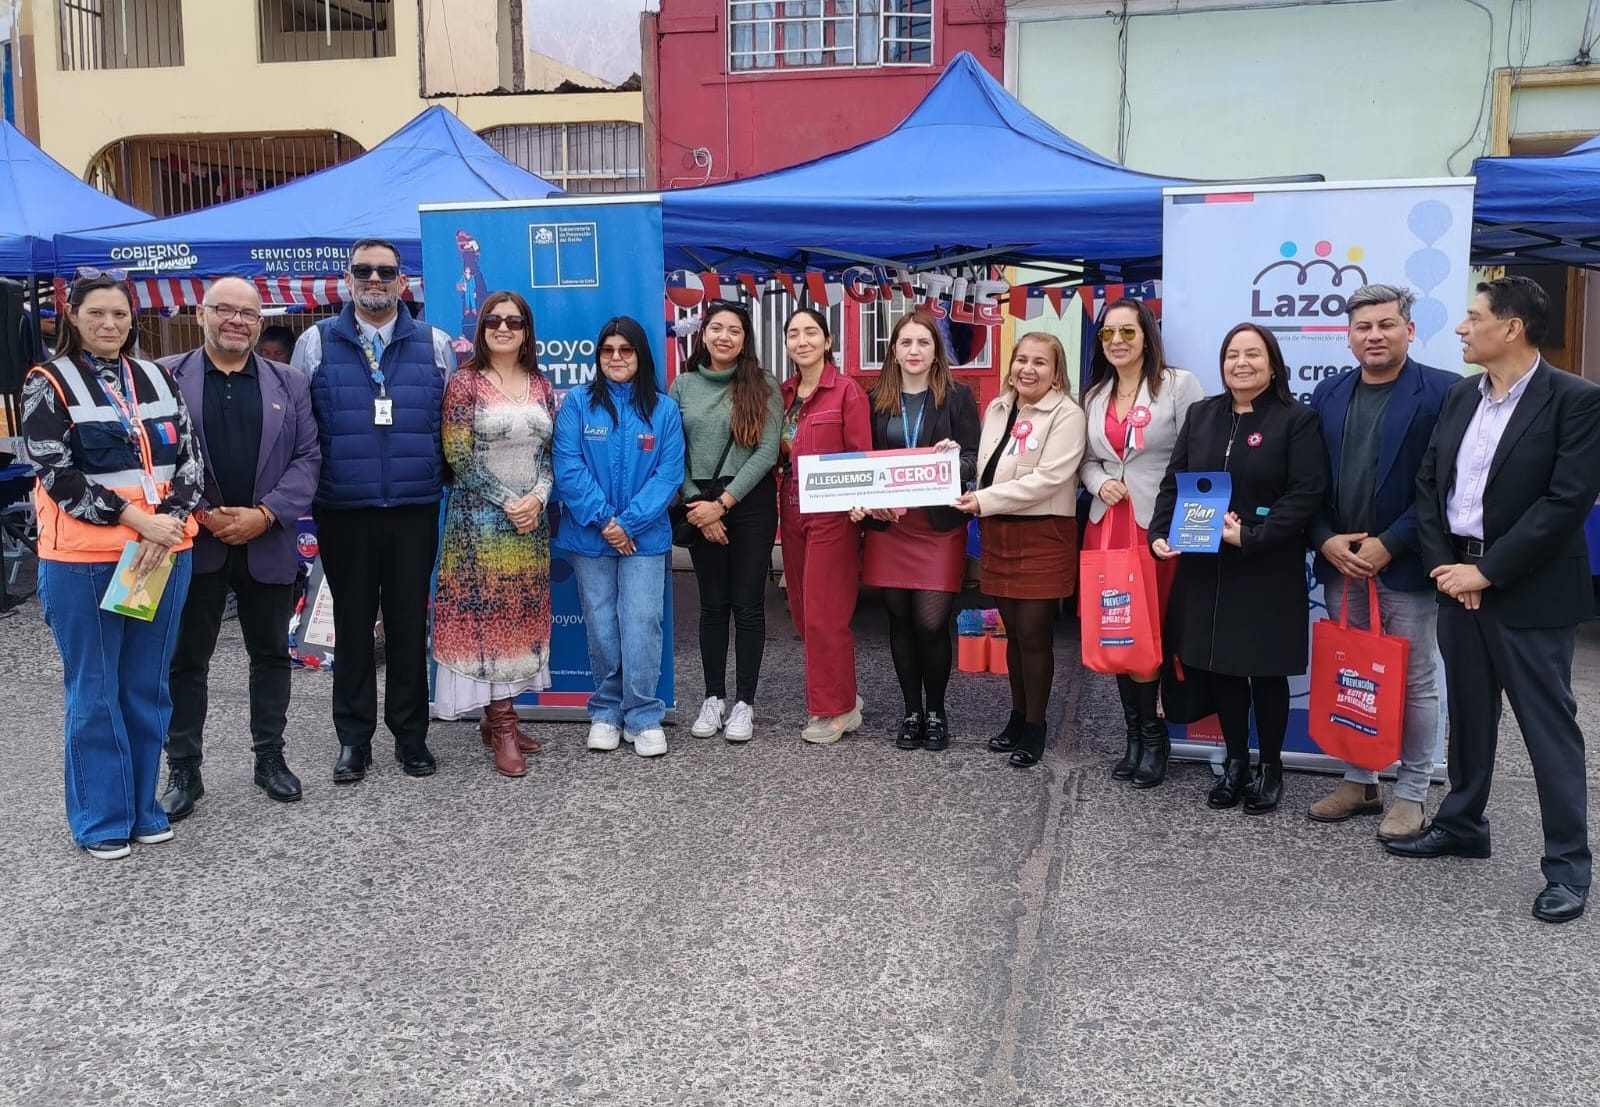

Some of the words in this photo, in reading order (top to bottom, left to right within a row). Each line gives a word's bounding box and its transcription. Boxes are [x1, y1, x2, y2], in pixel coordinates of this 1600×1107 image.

[111, 244, 190, 260] GOBIERNO
[250, 247, 313, 260] SERVICIOS
[265, 260, 290, 272] MÁS
[293, 260, 328, 272] CERCA
[332, 260, 347, 272] DE
[842, 265, 1010, 326] CHILE
[809, 472, 873, 486] #LLEGUEMOS
[878, 472, 887, 481] A
[893, 466, 936, 482] CERO
